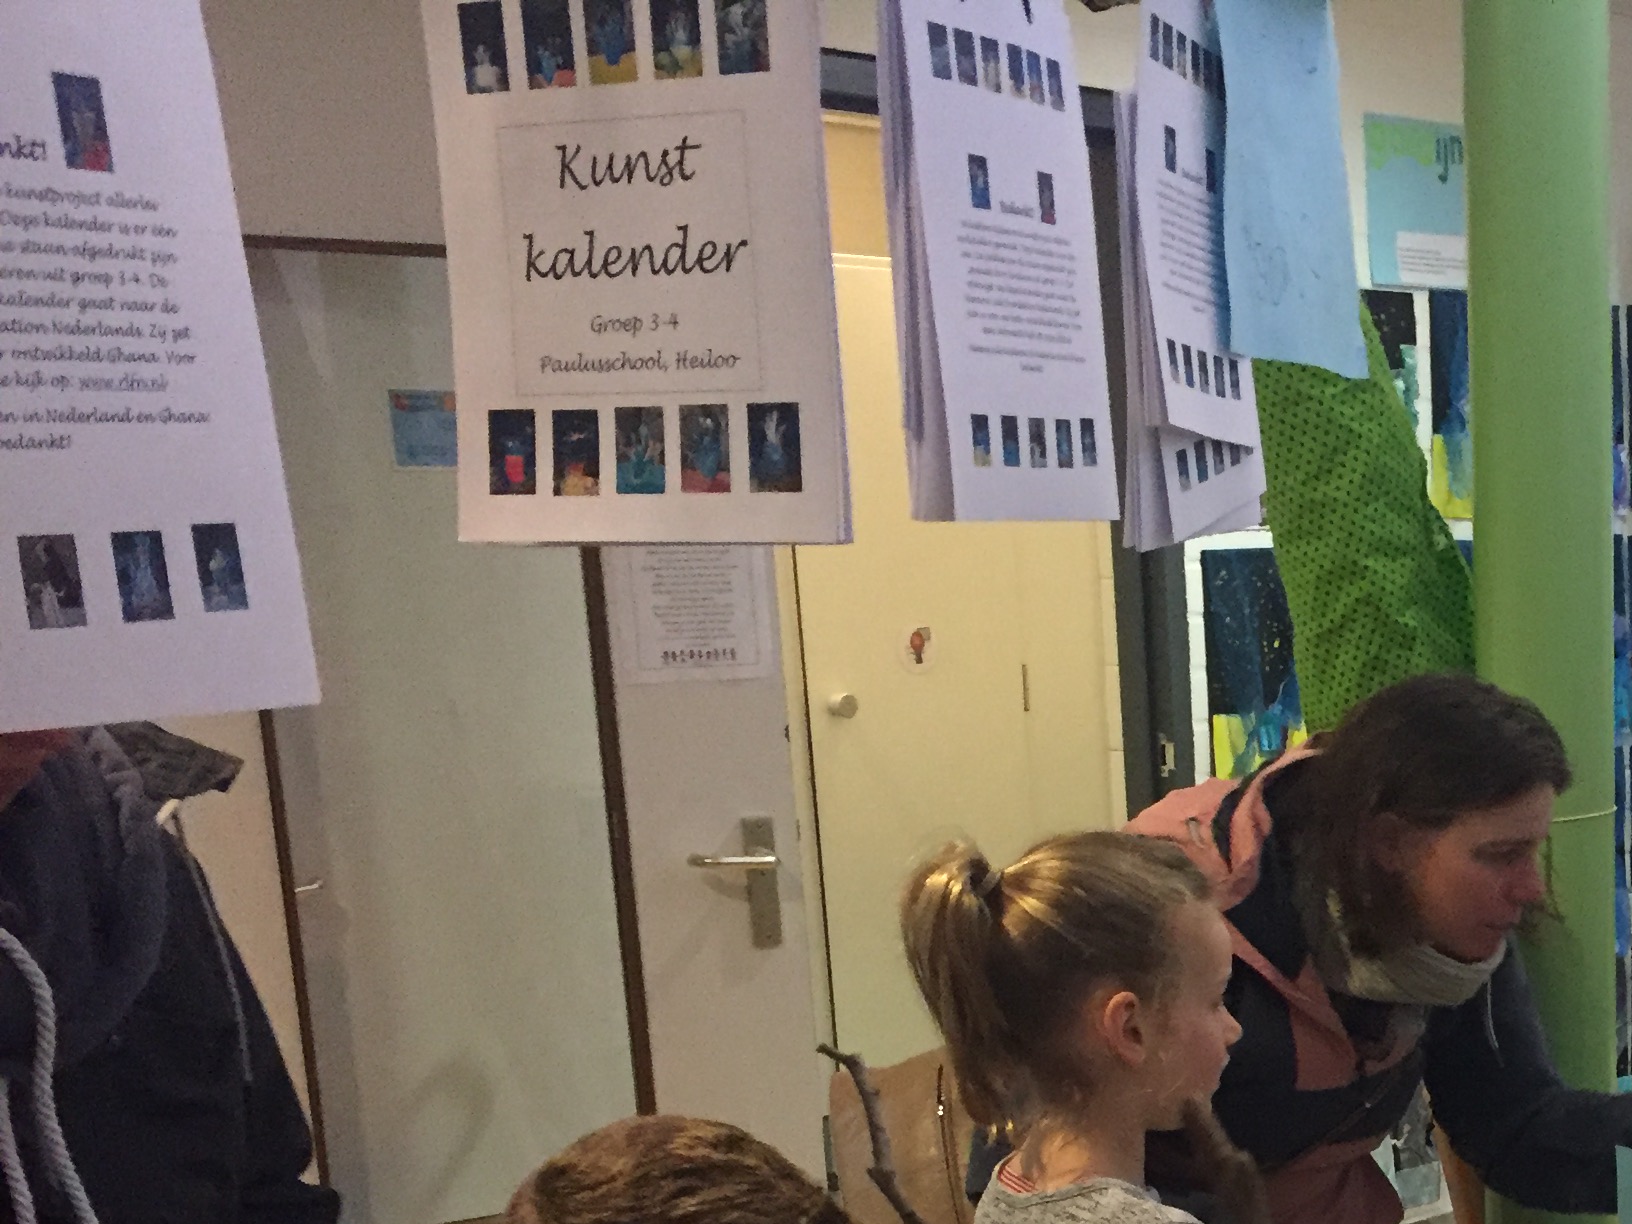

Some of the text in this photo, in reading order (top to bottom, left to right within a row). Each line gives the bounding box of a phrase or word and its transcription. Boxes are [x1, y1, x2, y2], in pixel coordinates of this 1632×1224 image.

[555, 135, 702, 191] Kunst
[523, 223, 749, 282] kalender
[590, 314, 644, 339] Groep
[539, 348, 741, 375] Paulusschool, Heiloo
[46, 406, 134, 424] Nederland
[0, 432, 72, 451] edankt!
